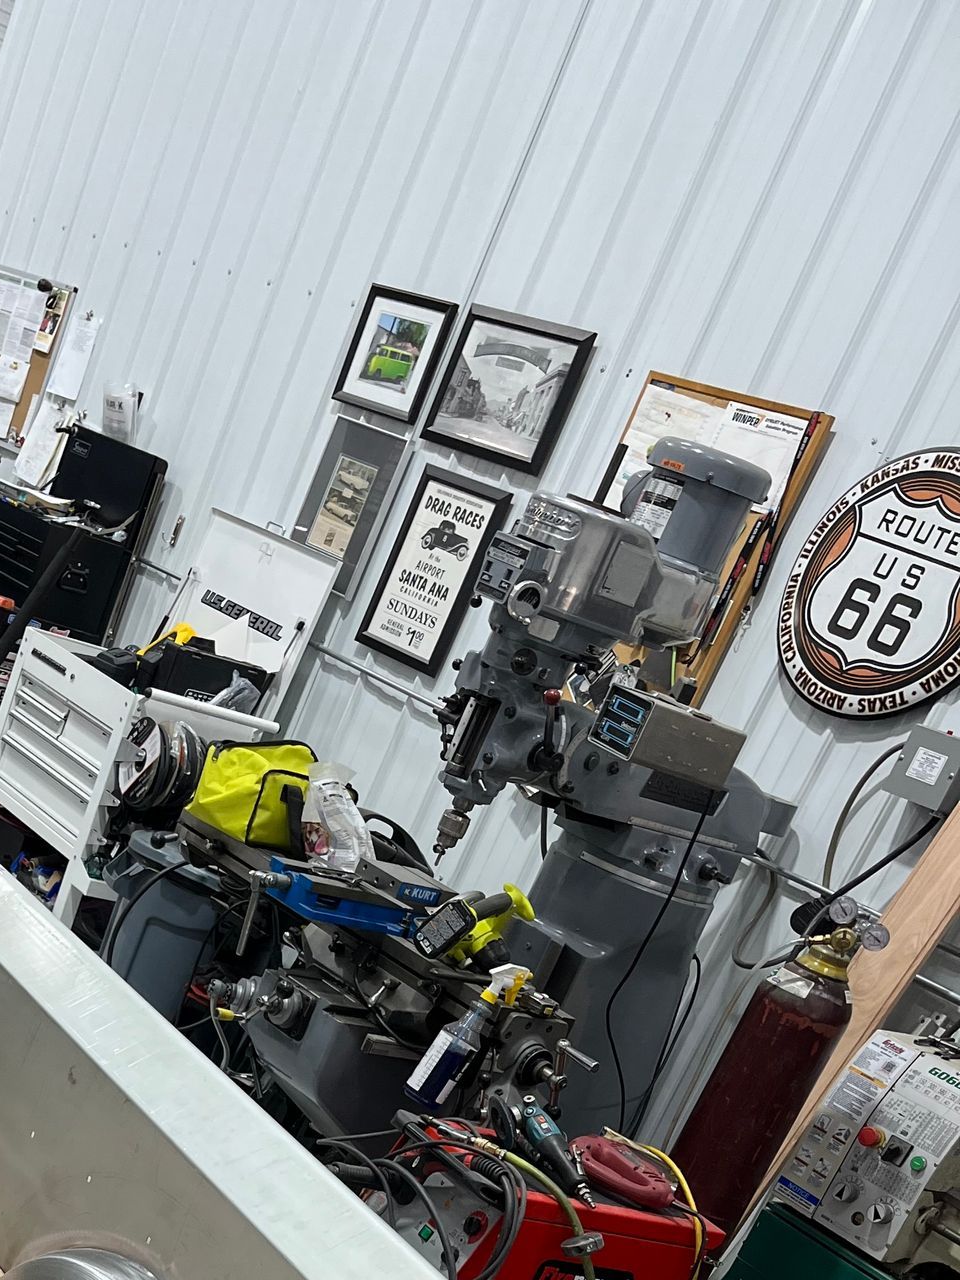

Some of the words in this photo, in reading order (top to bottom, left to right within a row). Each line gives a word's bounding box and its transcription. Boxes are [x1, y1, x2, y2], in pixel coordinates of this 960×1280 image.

[860, 455, 921, 496] KANSAS
[424, 495, 451, 517] DRAG
[451, 505, 485, 530] RACES
[801, 499, 850, 561] ILLINOIS
[877, 508, 960, 556] ROUTE
[399, 569, 428, 592] SANTA
[428, 581, 449, 602] ANA
[415, 560, 446, 580] AIRPORT
[873, 552, 925, 590] US
[386, 597, 438, 629] SUNDAYS
[400, 586, 439, 607] CALIFORNIA
[780, 572, 801, 663] CALIFORNIA
[827, 577, 923, 657] 66
[797, 667, 848, 713] ARIZONA
[857, 690, 910, 714] TEXAS
[411, 887, 437, 901] KURT
[787, 1182, 811, 1200] NOTICE
